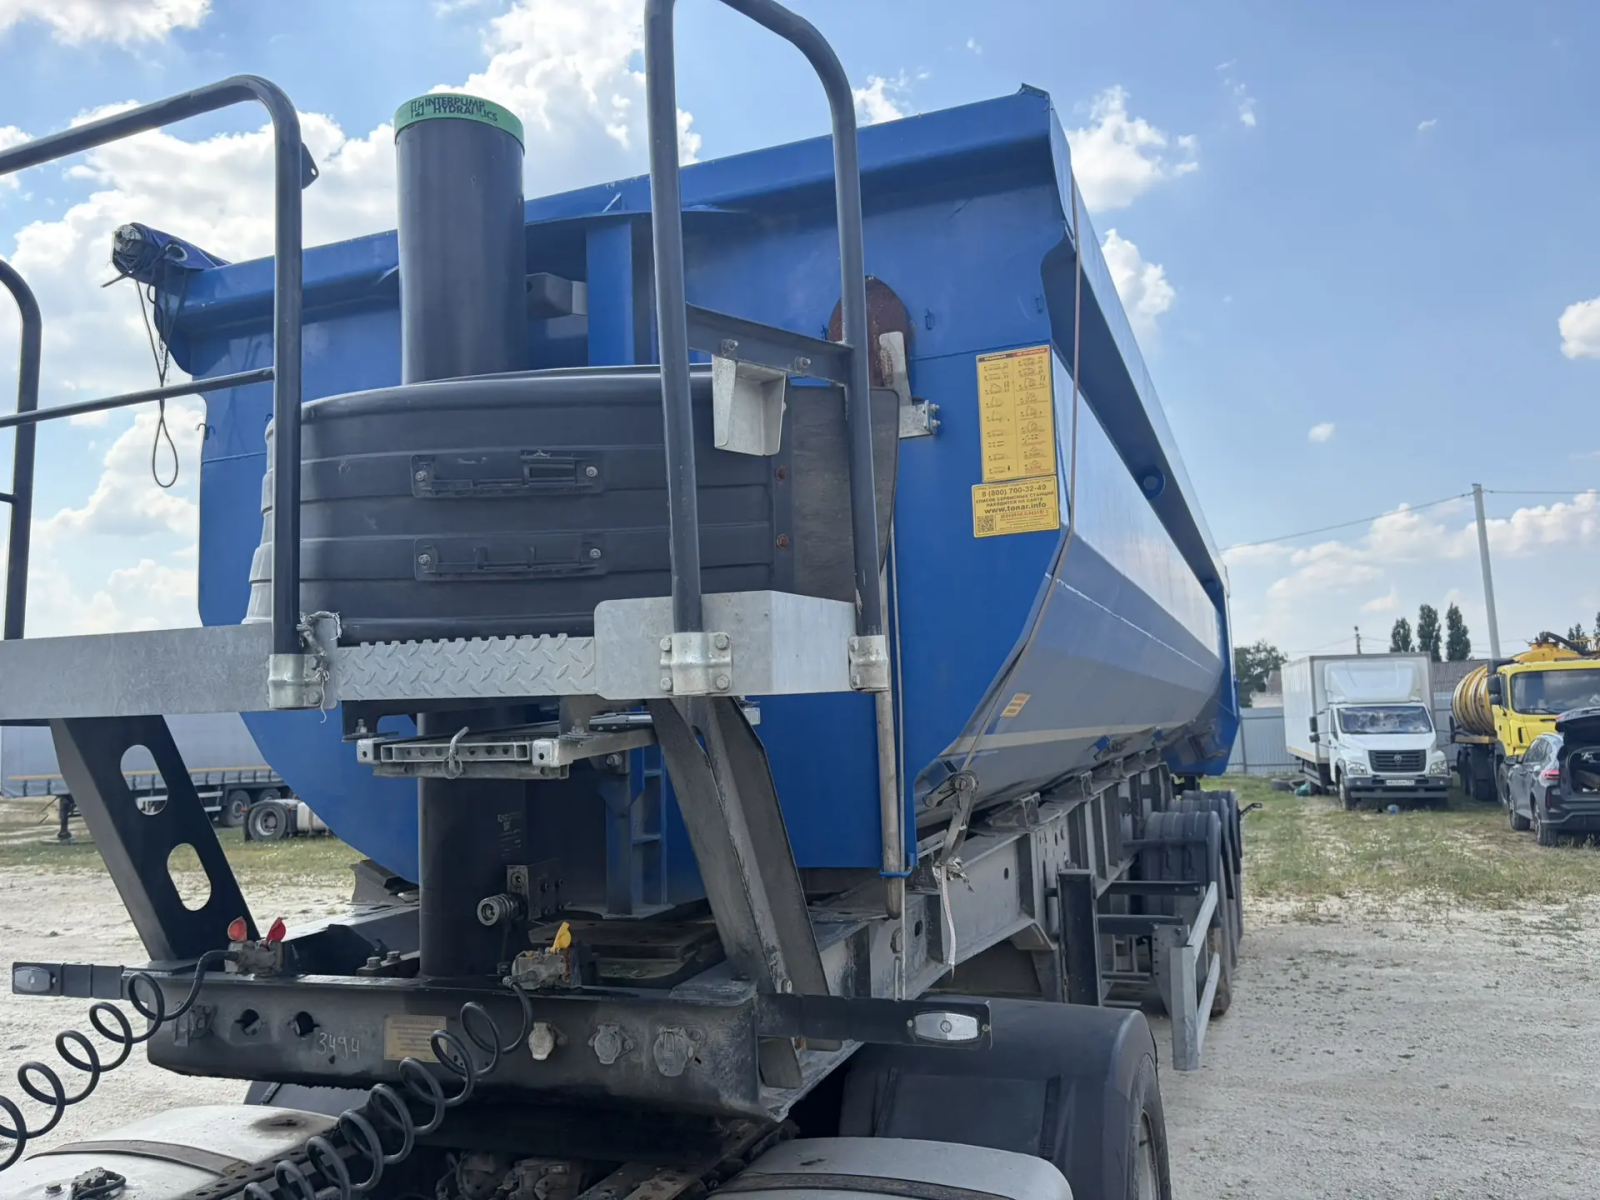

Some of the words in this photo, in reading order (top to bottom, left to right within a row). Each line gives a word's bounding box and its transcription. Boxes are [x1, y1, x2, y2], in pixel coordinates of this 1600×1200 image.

[425, 97, 485, 112] INTERPUMP
[988, 488, 1007, 498] (800)
[1009, 484, 1047, 495] 700-32-49
[997, 494, 1029, 502] СЕРВИСНЫХ
[984, 501, 1047, 514] www.tonar.info
[317, 1032, 360, 1060] 3494
